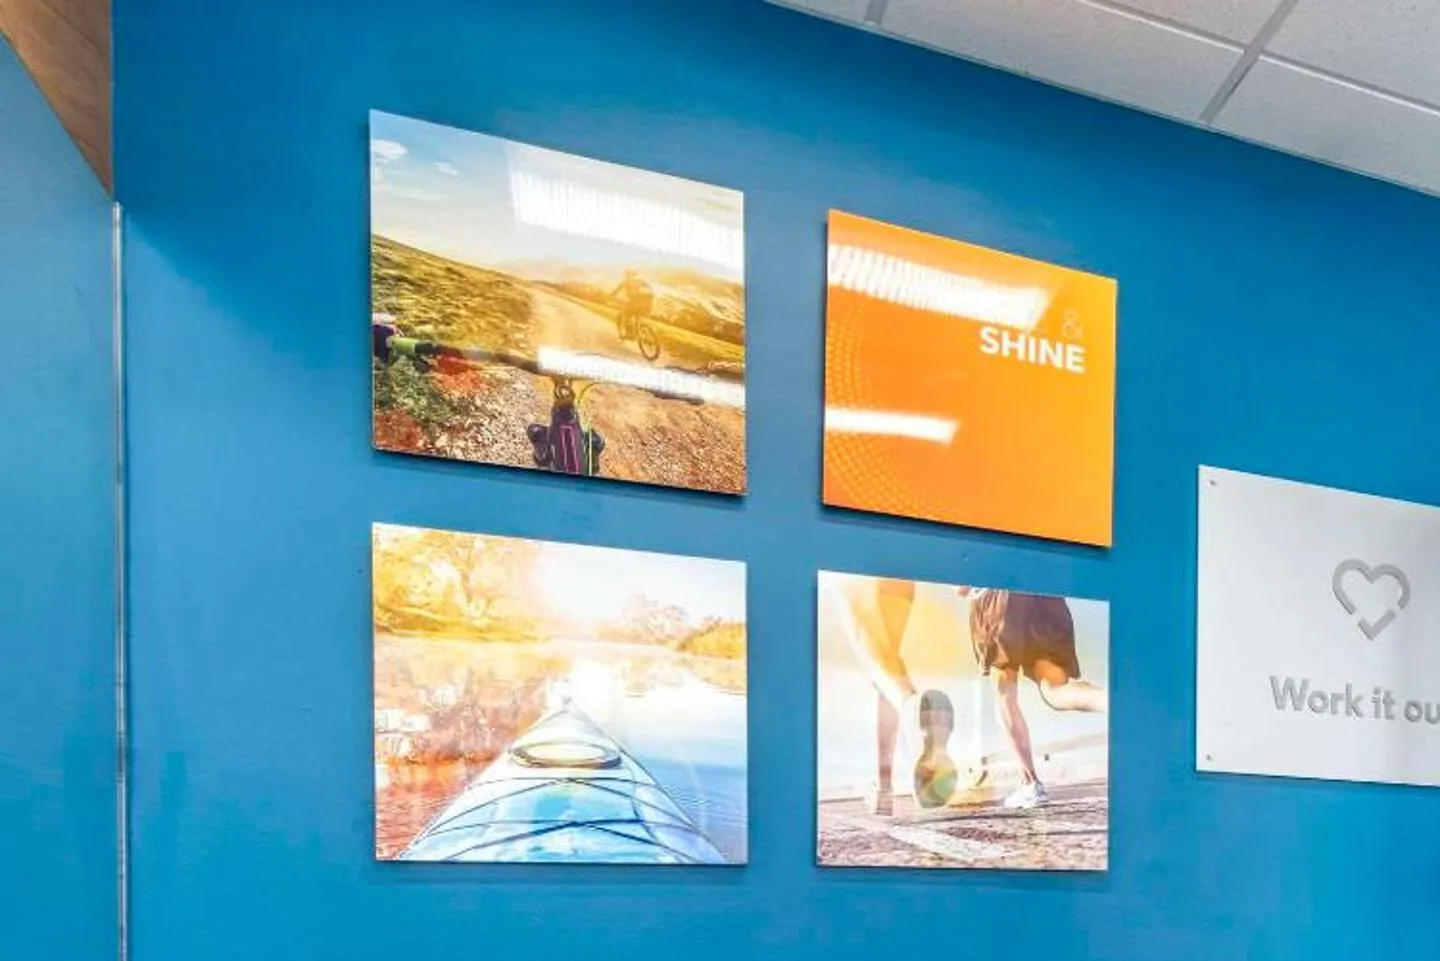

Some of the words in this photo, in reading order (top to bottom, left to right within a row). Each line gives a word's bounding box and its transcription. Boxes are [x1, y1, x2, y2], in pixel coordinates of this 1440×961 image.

[1061, 307, 1085, 339] &
[979, 326, 1085, 374] SHINE
[1270, 675, 1364, 718] Work
[1372, 687, 1394, 720] it
